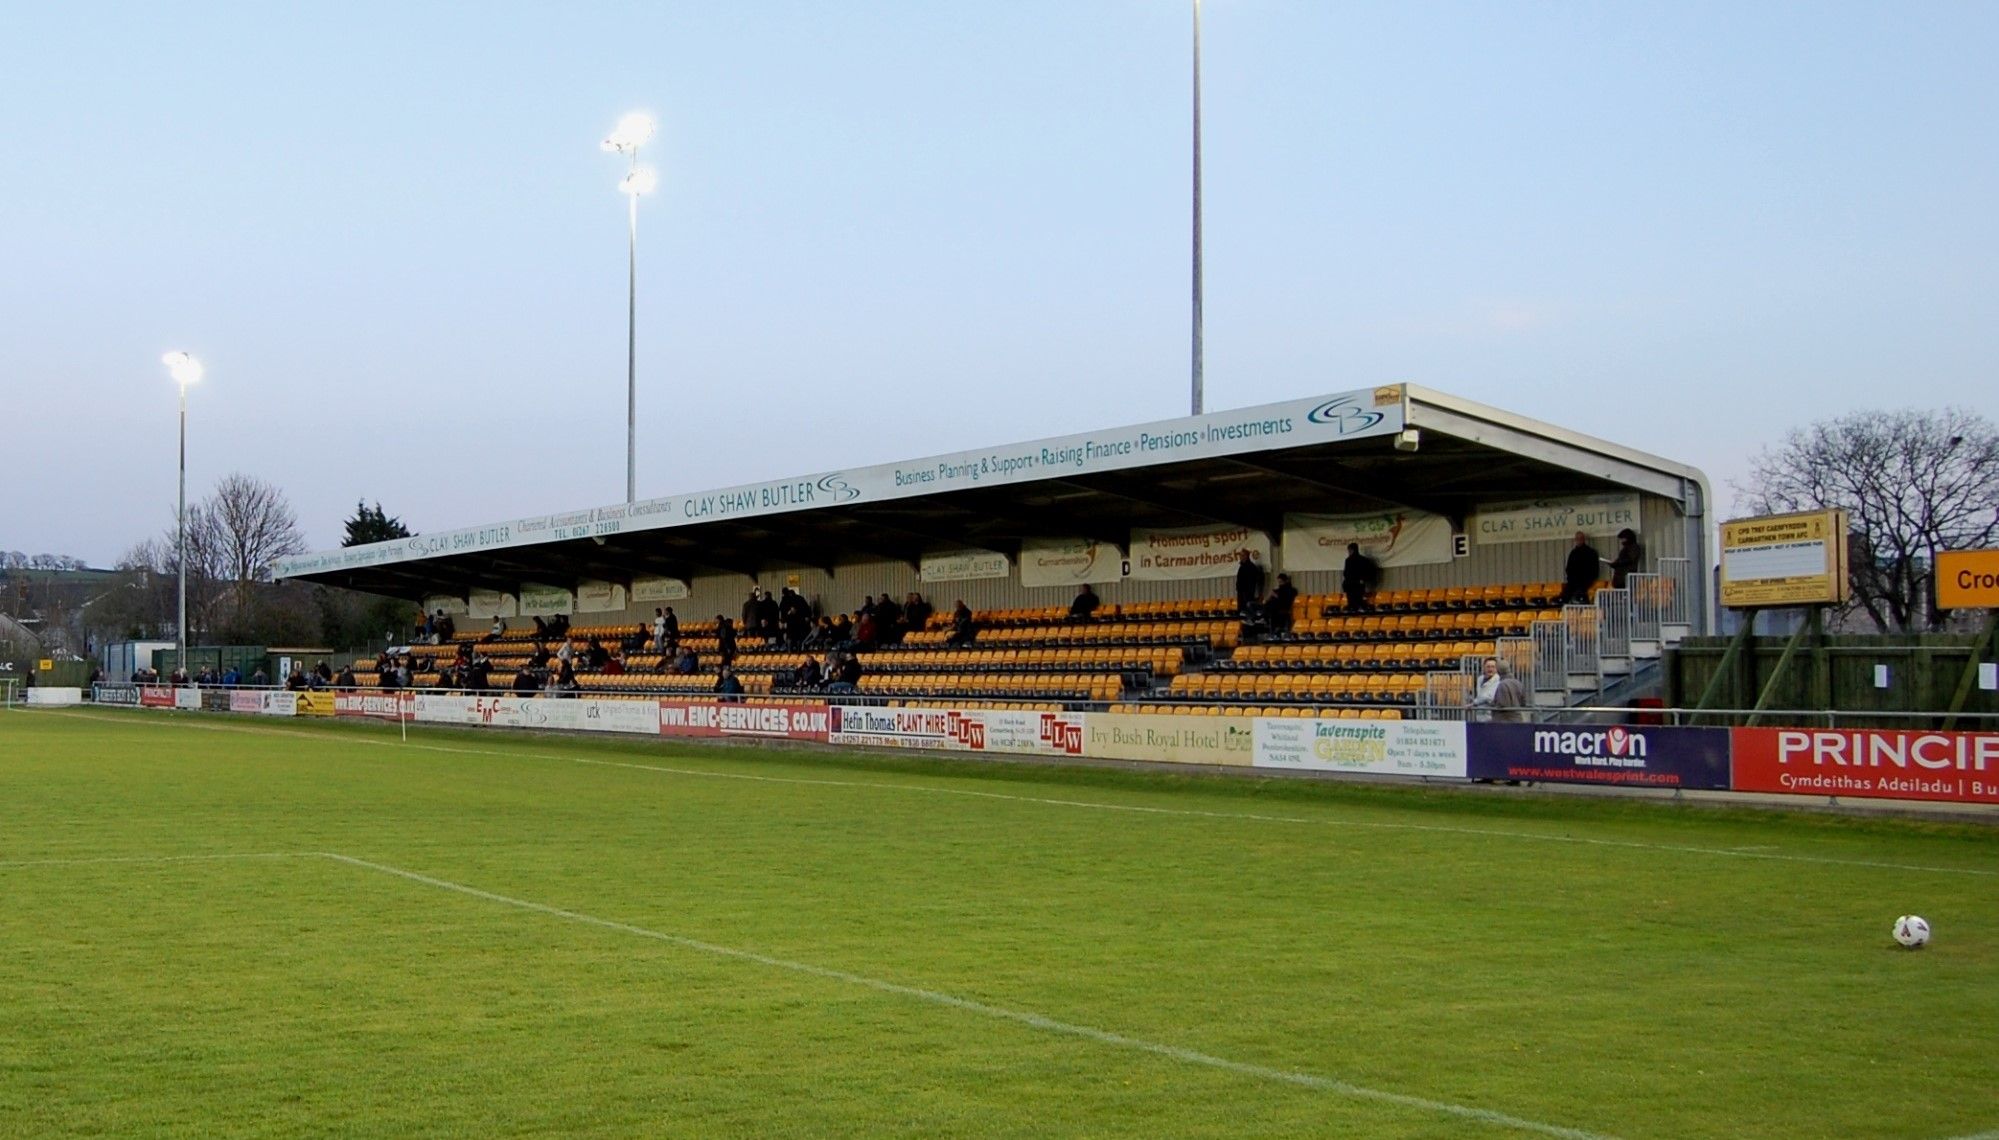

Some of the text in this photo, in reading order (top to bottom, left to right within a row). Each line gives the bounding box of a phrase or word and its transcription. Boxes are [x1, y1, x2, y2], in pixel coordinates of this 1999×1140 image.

[895, 417, 1292, 487] Business Planning & Support Raising Finance Pensions Investments
[684, 482, 815, 518] CLAY SHAW BUTLER
[1481, 510, 1633, 533] CLAY SHAW BUTLER
[429, 526, 510, 553] CLAY SHAW BUTLER
[1149, 528, 1249, 548] Promoting sport
[1454, 536, 1467, 555] E
[1121, 560, 1131, 576] D
[1140, 550, 1260, 568] in Carmarthenshe
[1957, 569, 1999, 590] Cro
[865, 712, 895, 731] Thomas
[897, 713, 923, 732] PLANT
[925, 714, 945, 734] HIRE
[1315, 722, 1386, 741] Tavernspite
[1091, 727, 1108, 749] Ivy
[1112, 726, 1143, 745] Bush
[1147, 728, 1180, 751] Royal
[1184, 730, 1219, 749] Hotel
[1534, 726, 1647, 757] macron
[1507, 766, 1679, 785] www.westwalesprint.com
[1780, 773, 1871, 790] Cymdeithas
[1877, 777, 1952, 793] Adeiladu
